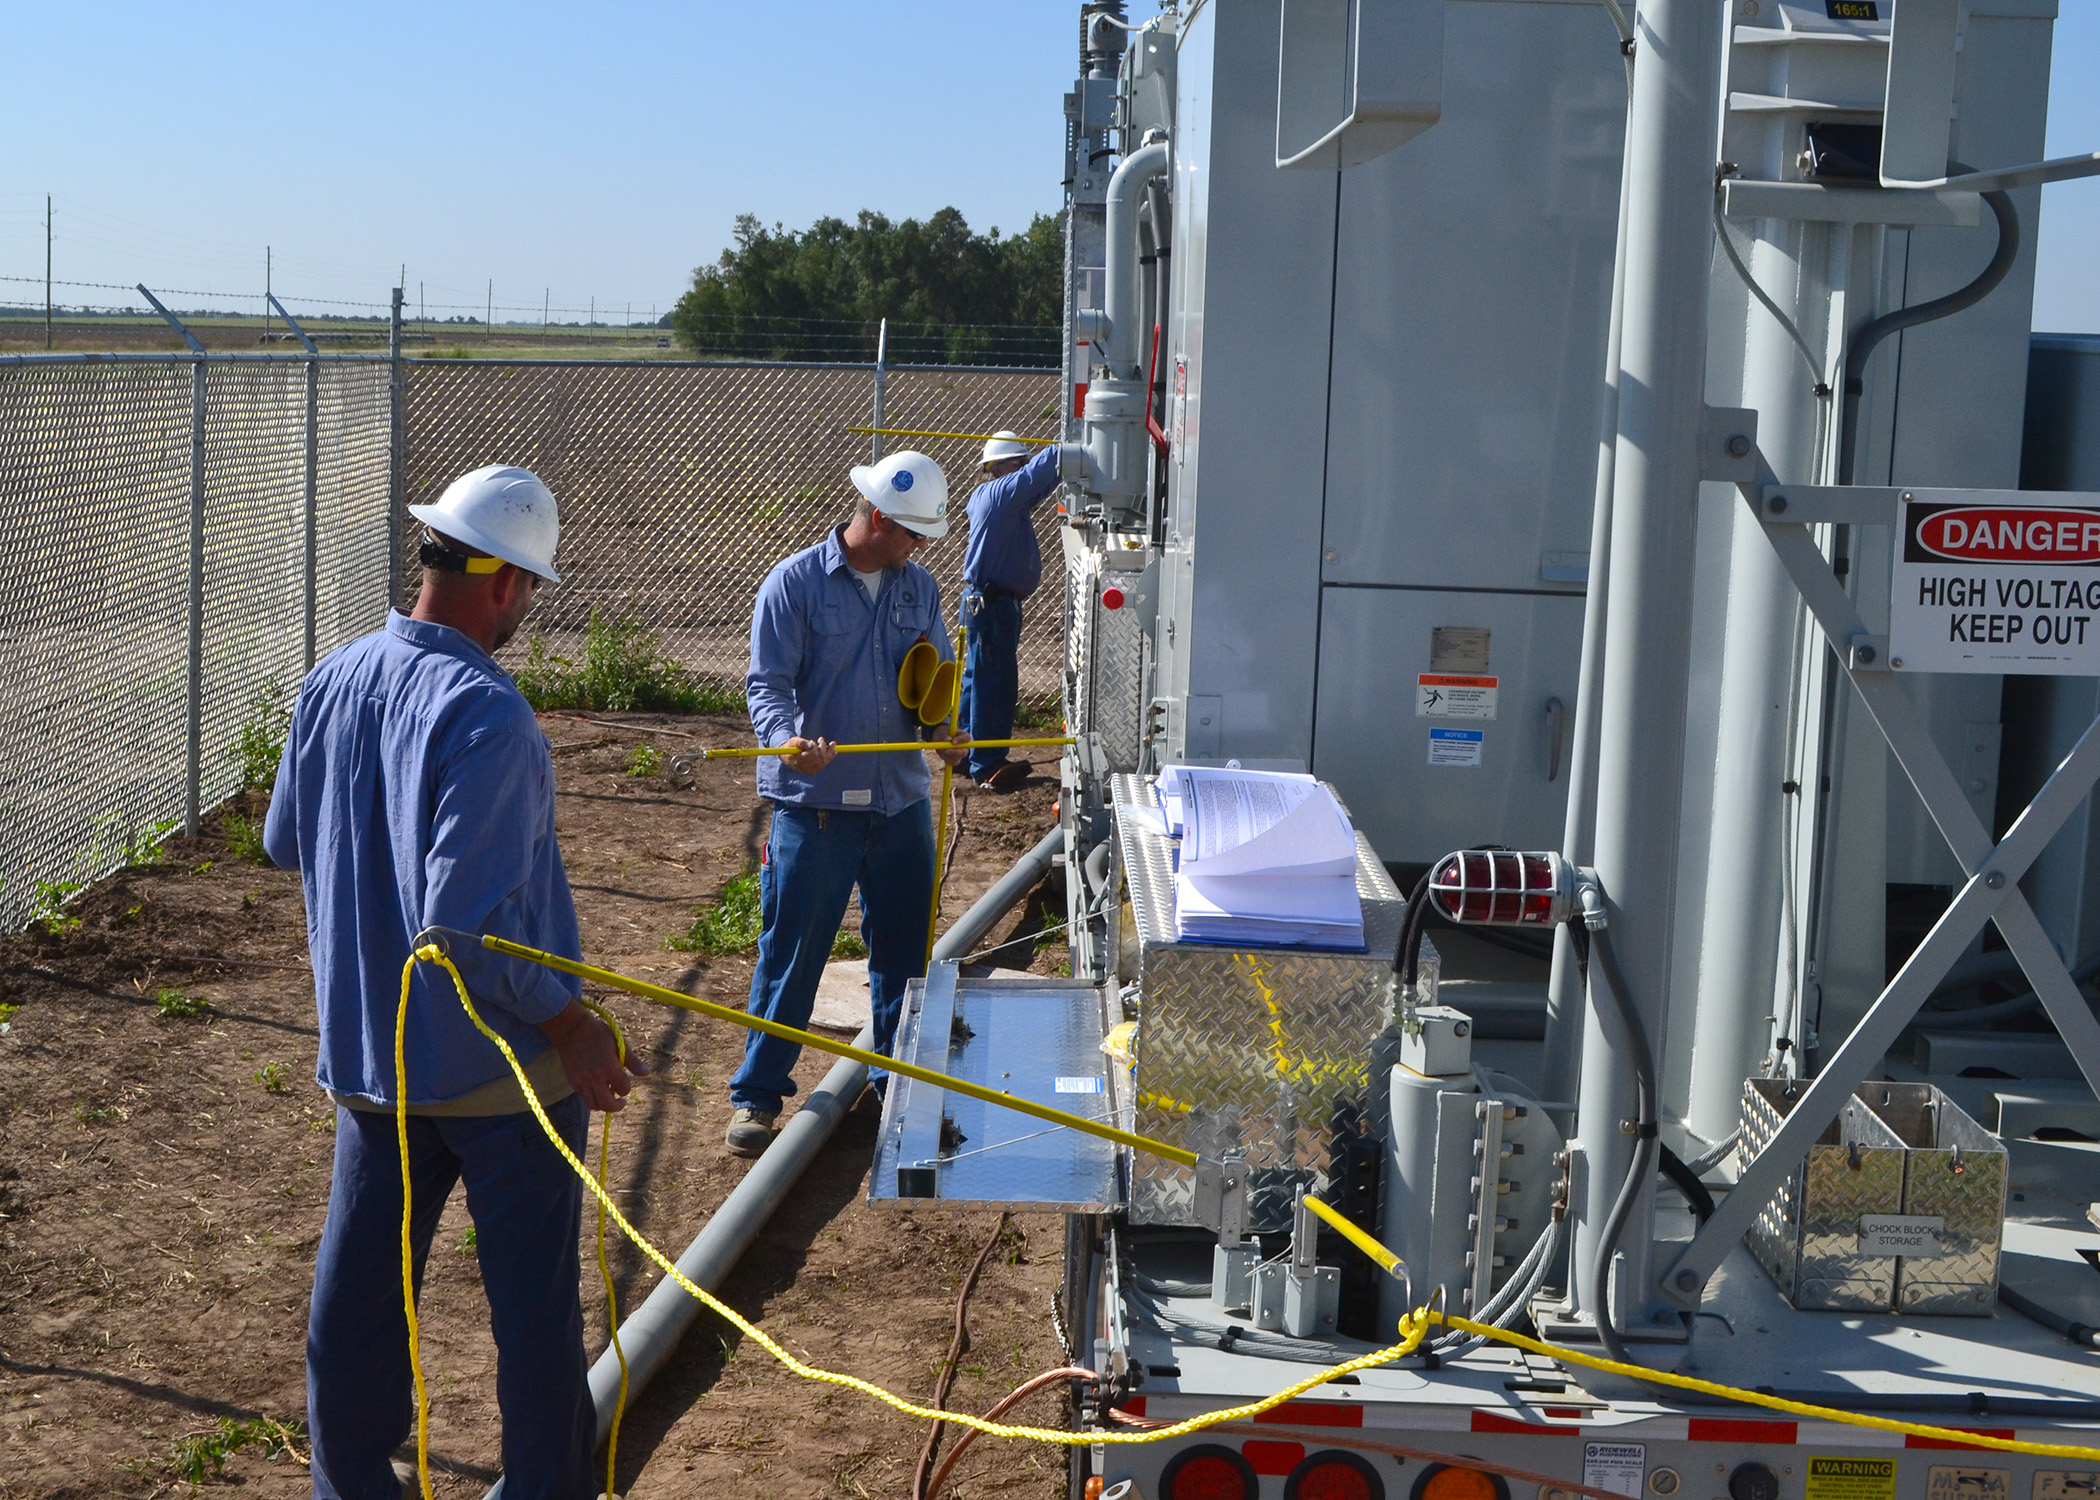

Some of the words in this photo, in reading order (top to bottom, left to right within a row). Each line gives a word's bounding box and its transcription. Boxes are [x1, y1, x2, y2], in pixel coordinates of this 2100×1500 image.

[1834, 3, 1870, 17] 165:1
[1942, 518, 2100, 552] DANGER
[1919, 577, 1986, 607] HIGH
[1949, 613, 2023, 643] KEEP
[2032, 615, 2090, 645] OUT
[1868, 1224, 1902, 1233] CHOCK
[1904, 1226, 1934, 1234] BLOCK
[1879, 1236, 1922, 1246] STORAGE
[1816, 1462, 1891, 1476] WARNING
[1932, 1472, 1952, 1488] M
